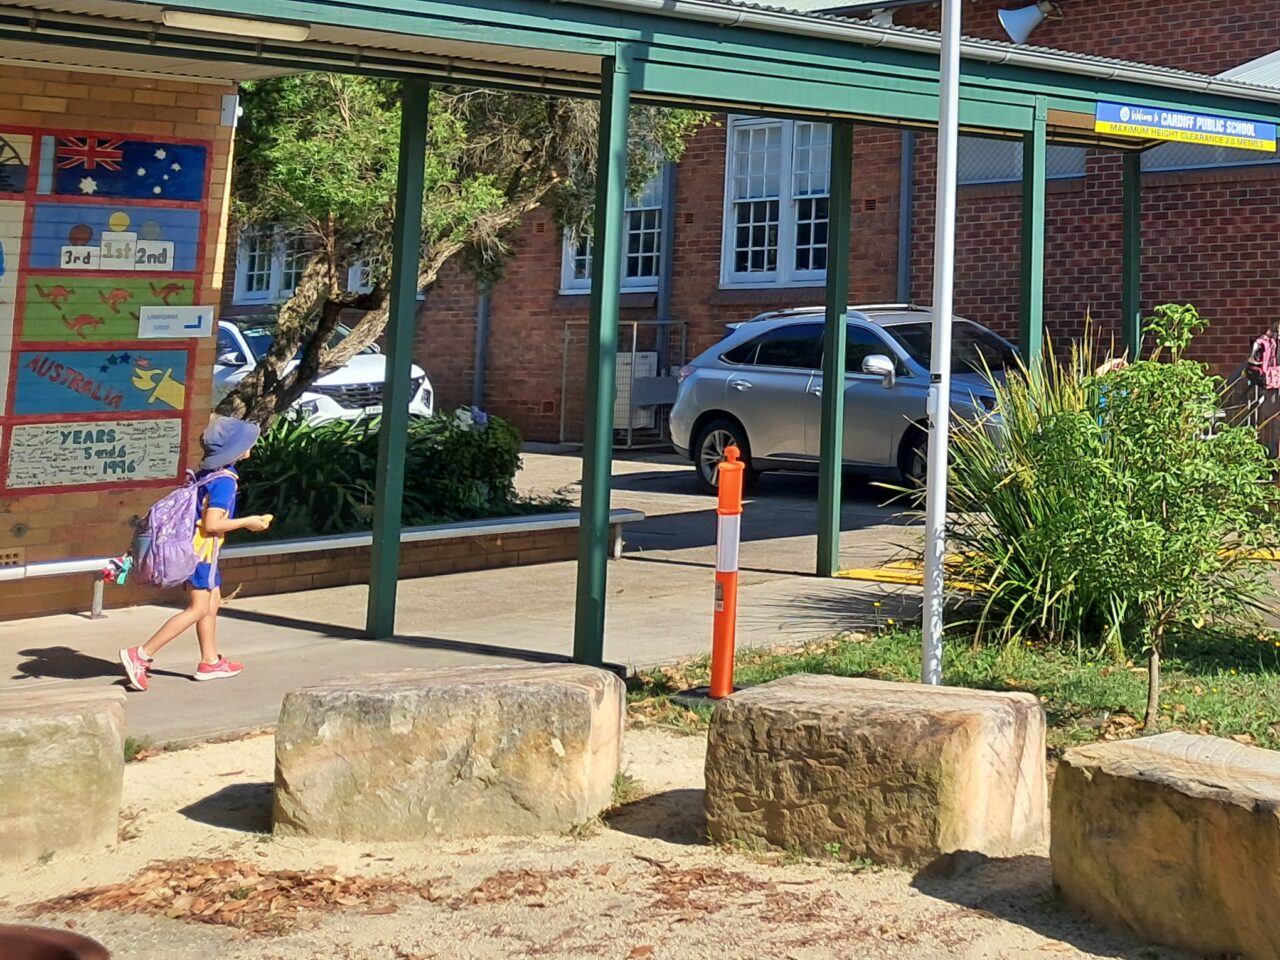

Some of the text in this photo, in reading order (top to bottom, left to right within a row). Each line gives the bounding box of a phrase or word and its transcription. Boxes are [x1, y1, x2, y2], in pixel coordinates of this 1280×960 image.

[1161, 112, 1195, 129] CARDIFF
[1196, 116, 1225, 133] PUBLIC
[1226, 121, 1256, 137] SCHOOL
[1110, 124, 1149, 135] MAXIMUM
[1151, 129, 1179, 139] HEIGHT
[1181, 132, 1224, 144] CLEARANCE
[1237, 138, 1264, 148] METRES
[64, 249, 91, 265] 3rd
[102, 240, 132, 260] 1st
[135, 246, 168, 265] 2nd
[25, 352, 124, 409] AUSTRALIA
[60, 428, 116, 445] YEARS
[83, 444, 127, 460] 5 and 6
[102, 460, 136, 474] 1996
